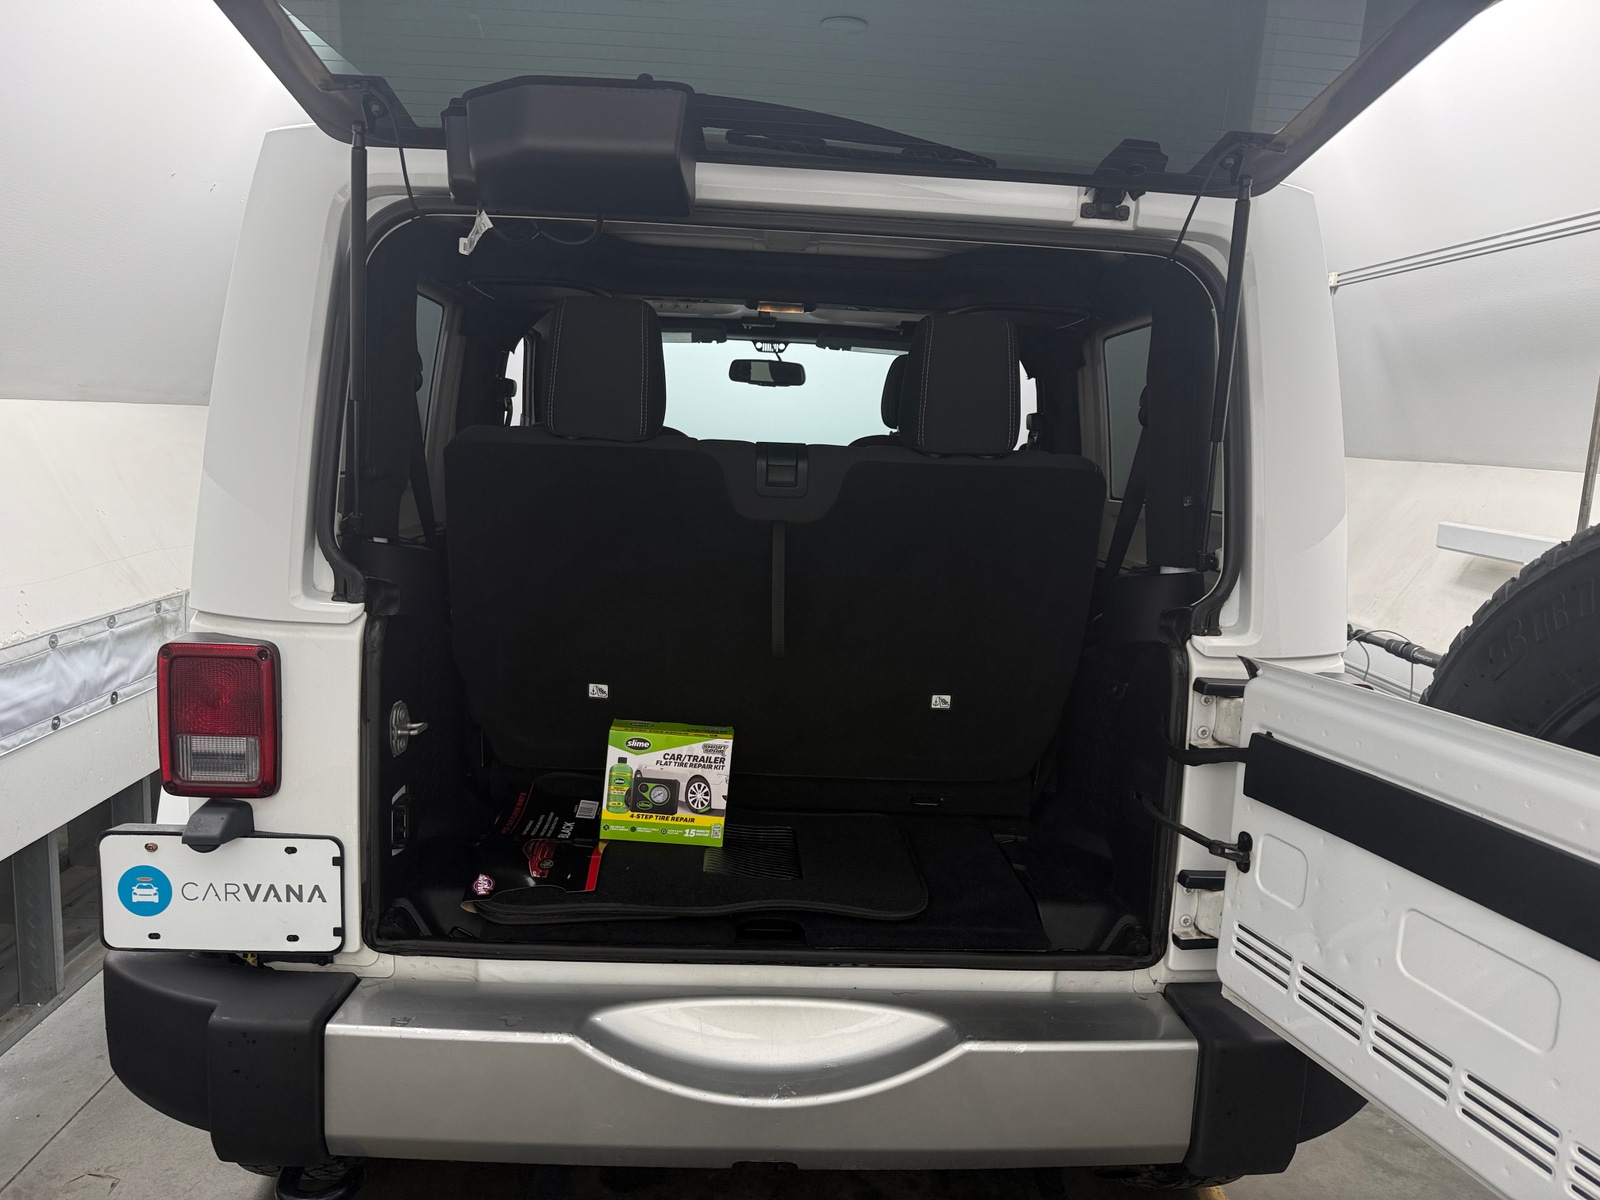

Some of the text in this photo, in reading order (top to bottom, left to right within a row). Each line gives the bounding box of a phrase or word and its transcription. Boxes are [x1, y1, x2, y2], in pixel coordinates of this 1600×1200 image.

[627, 739, 650, 748] slime
[663, 753, 726, 765] CAR/TRAILER
[557, 821, 576, 839] BLACK
[684, 828, 696, 838] 15
[181, 881, 328, 903] CARVANA
